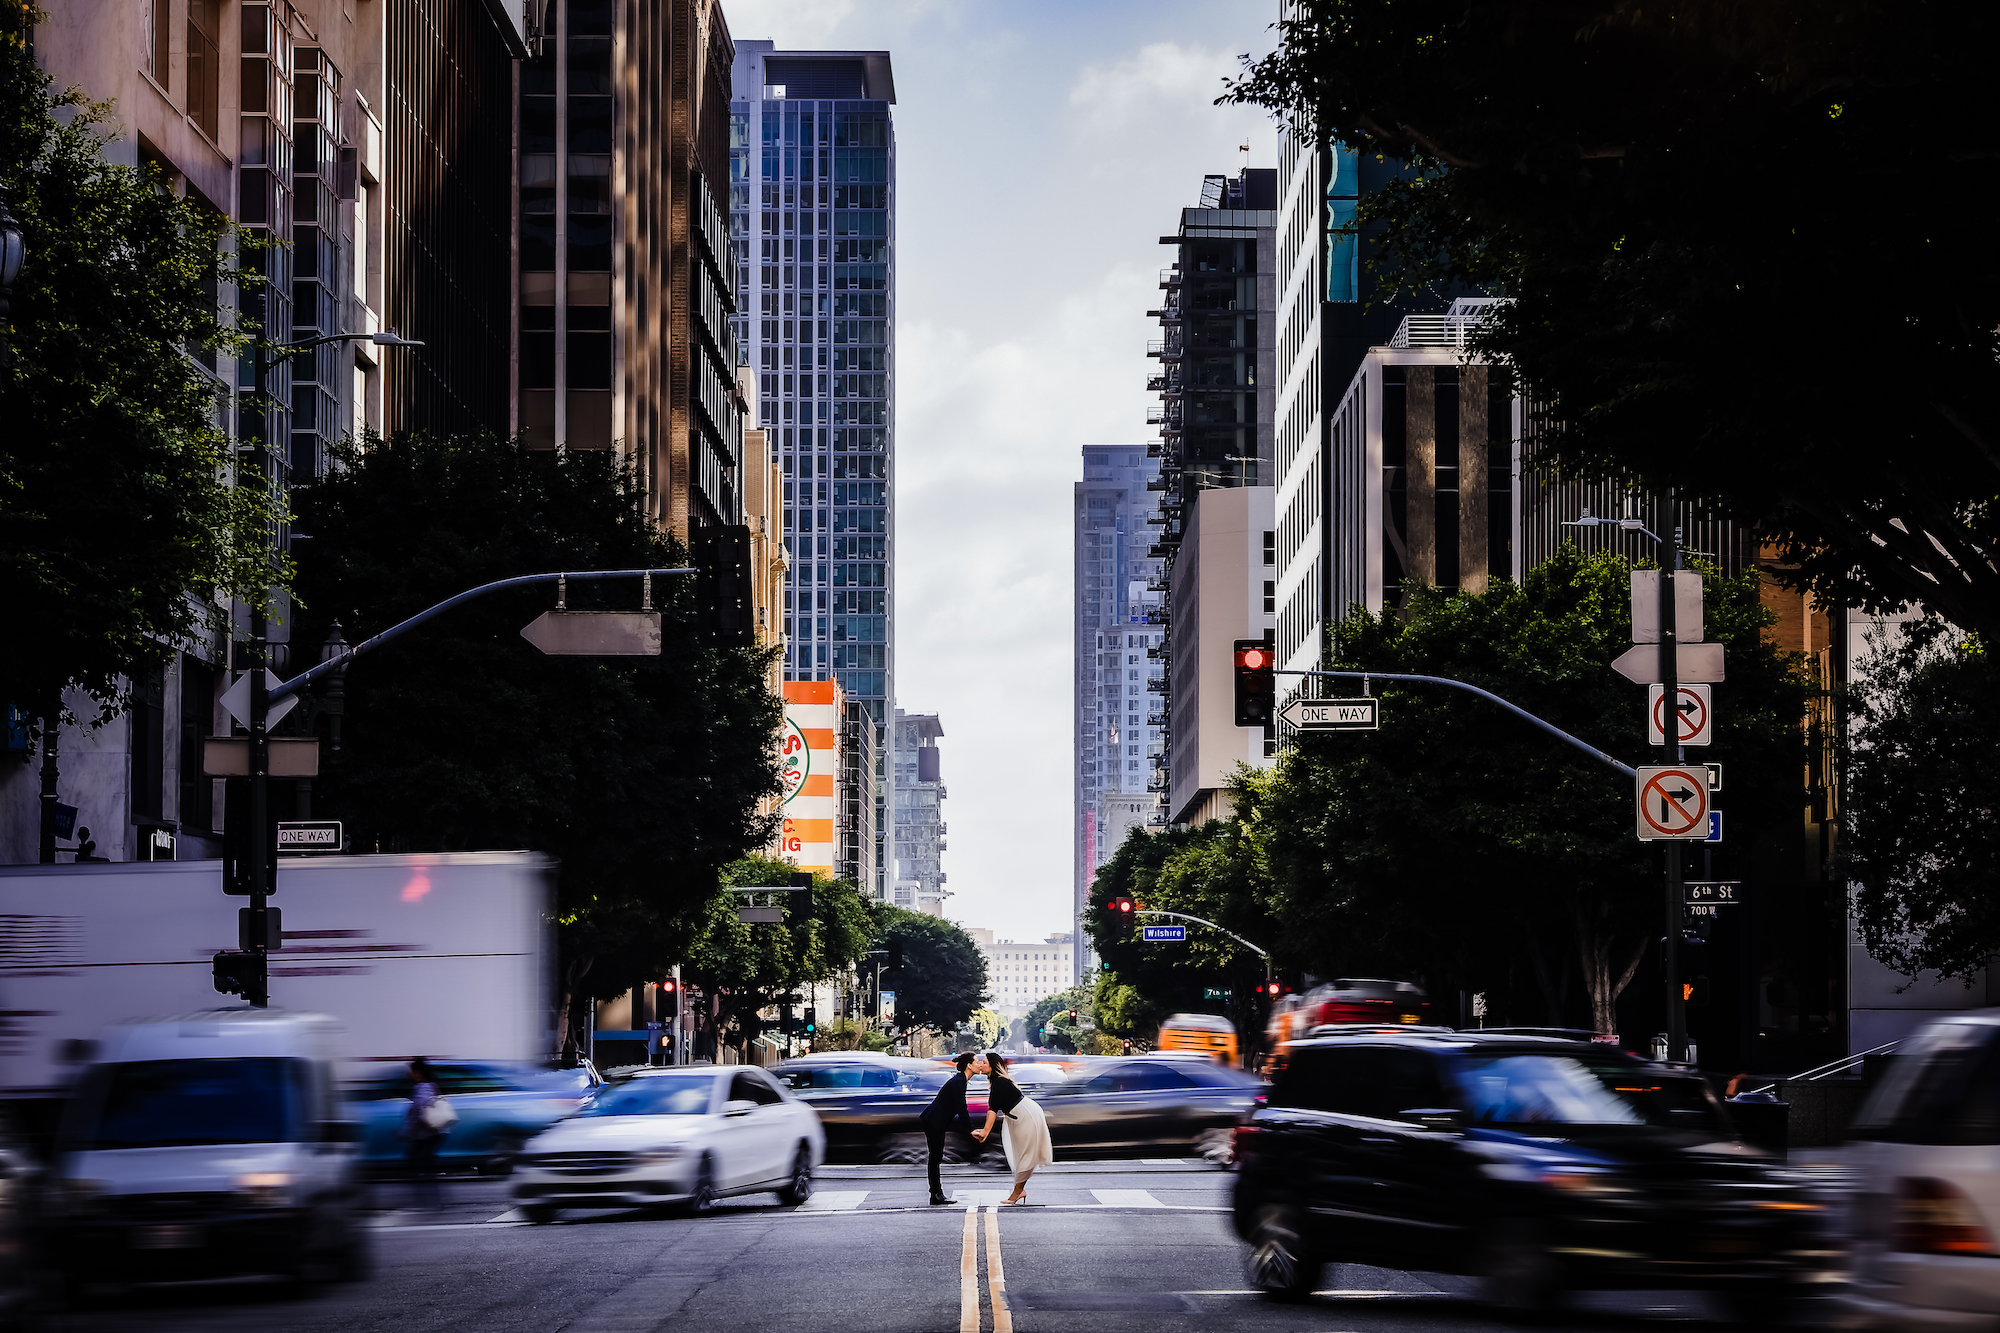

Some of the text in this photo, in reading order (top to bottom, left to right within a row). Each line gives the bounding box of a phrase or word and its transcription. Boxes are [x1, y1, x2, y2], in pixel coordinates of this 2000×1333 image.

[1301, 707, 1368, 721] ONE WAY
[280, 831, 332, 842] ONE WAY
[1692, 885, 1733, 899] 6th St
[1690, 906, 1708, 916] 700
[1147, 929, 1182, 938] Wilshire
